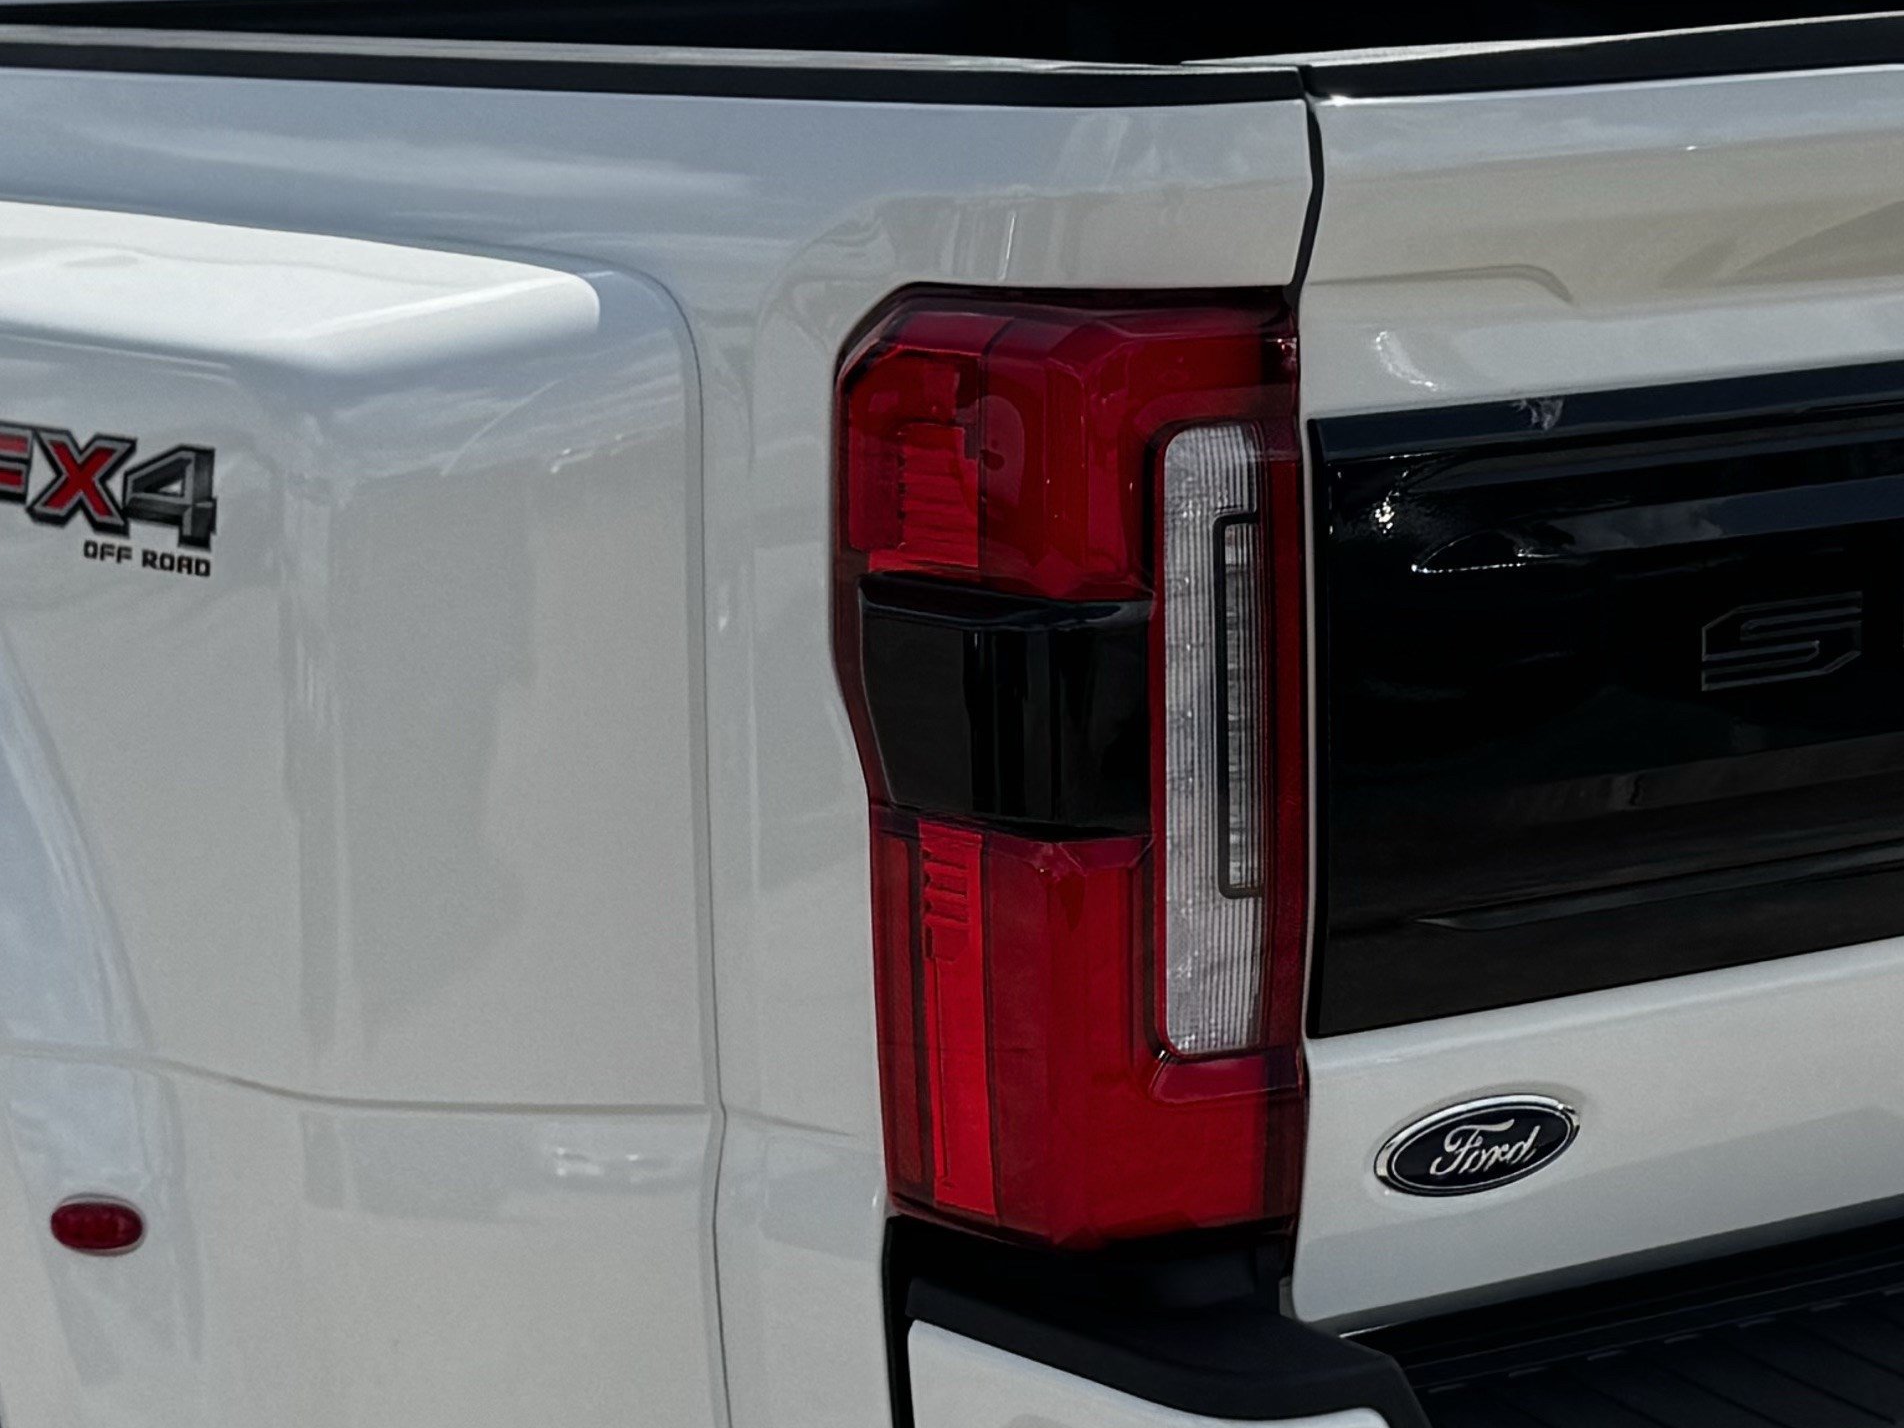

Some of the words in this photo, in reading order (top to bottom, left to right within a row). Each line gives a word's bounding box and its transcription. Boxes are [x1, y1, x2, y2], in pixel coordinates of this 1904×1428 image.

[82, 539, 132, 564] OFF
[141, 548, 212, 578] ROAD
[1429, 1118, 1542, 1175] Ford
